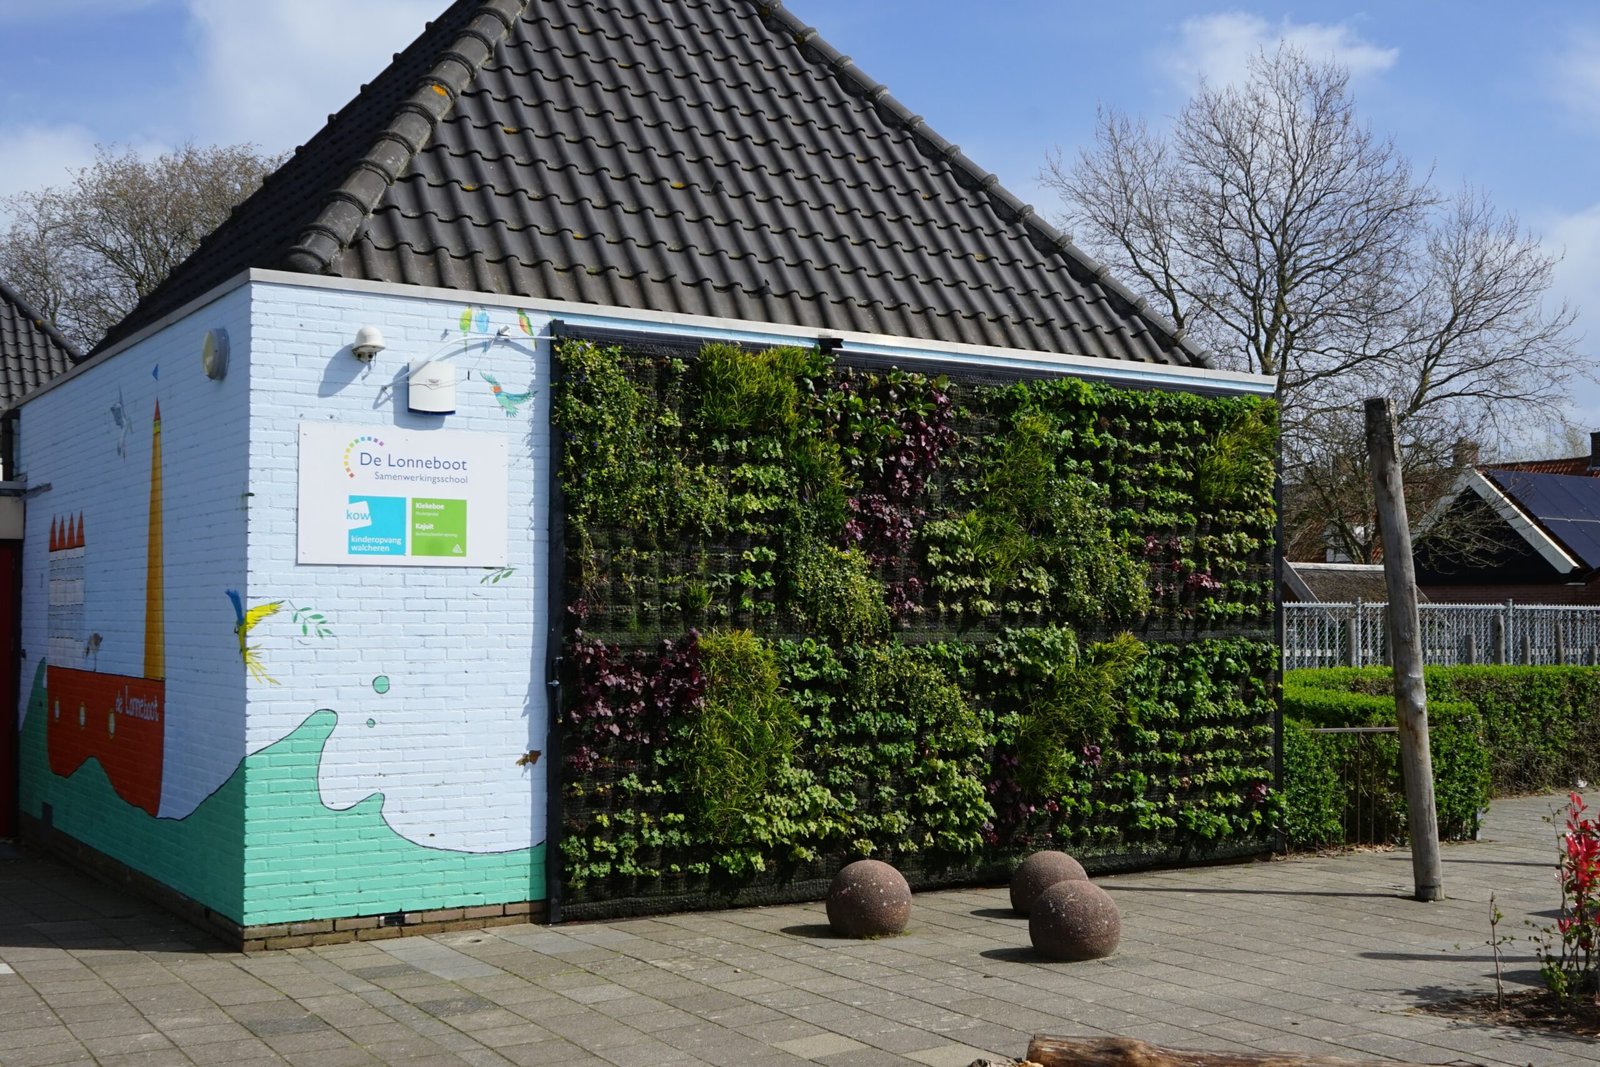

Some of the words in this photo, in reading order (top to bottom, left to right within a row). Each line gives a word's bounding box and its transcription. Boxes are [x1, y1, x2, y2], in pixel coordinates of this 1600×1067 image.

[360, 452, 382, 467] De
[388, 453, 467, 471] Lonneboot
[374, 471, 468, 484] Samenwerkingsschool
[415, 502, 445, 510] Kiekeboe
[346, 510, 370, 520] kow
[351, 535, 402, 545] kinderopvang
[351, 544, 390, 552] walcheren
